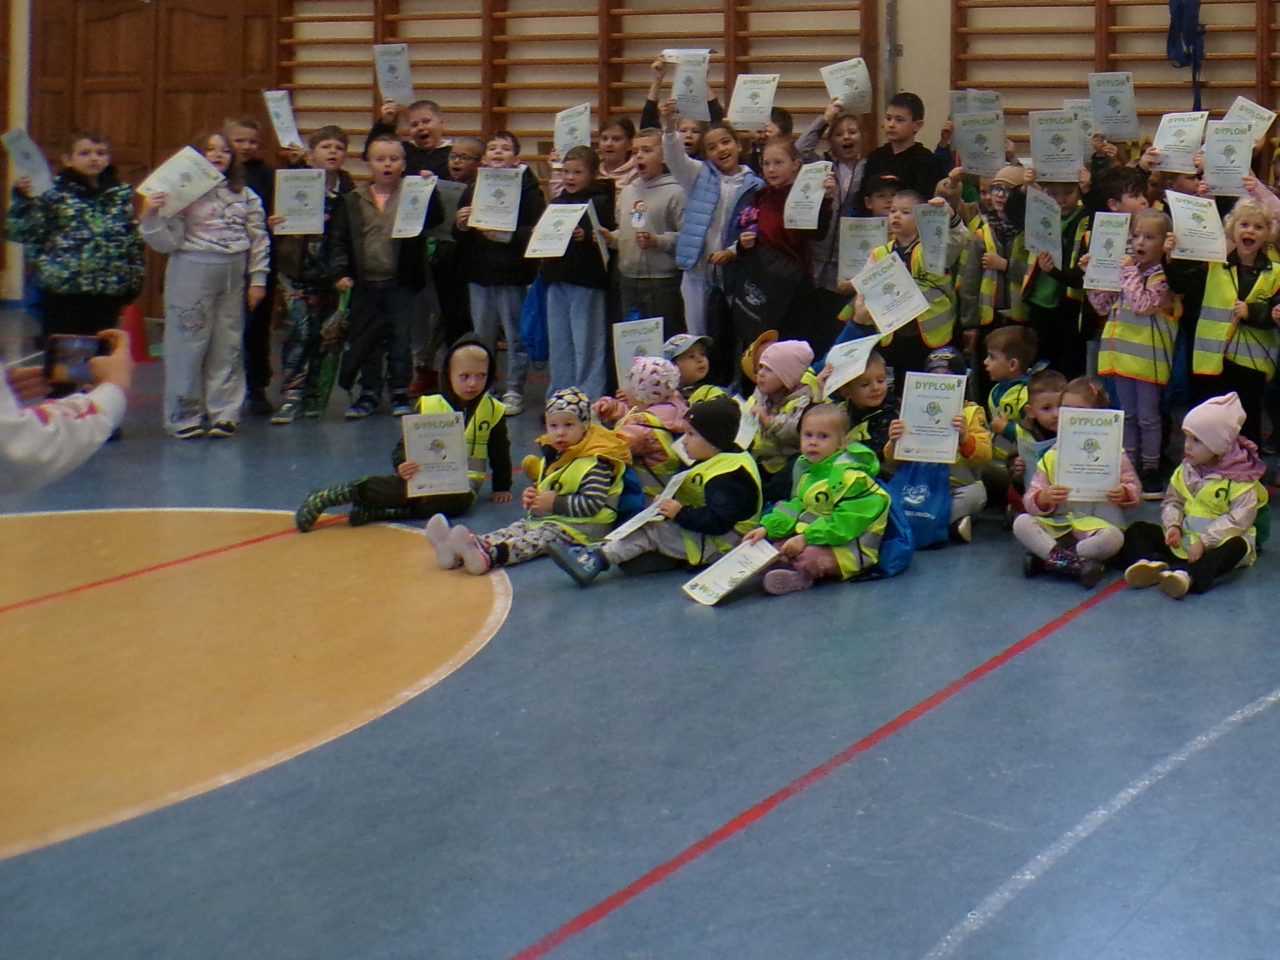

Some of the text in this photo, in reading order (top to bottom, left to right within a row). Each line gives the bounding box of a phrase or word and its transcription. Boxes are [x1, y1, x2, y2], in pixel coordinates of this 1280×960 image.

[1214, 127, 1247, 135] DYPLOM
[915, 381, 955, 391] DYPLOM
[1069, 416, 1113, 427] DYPLOM
